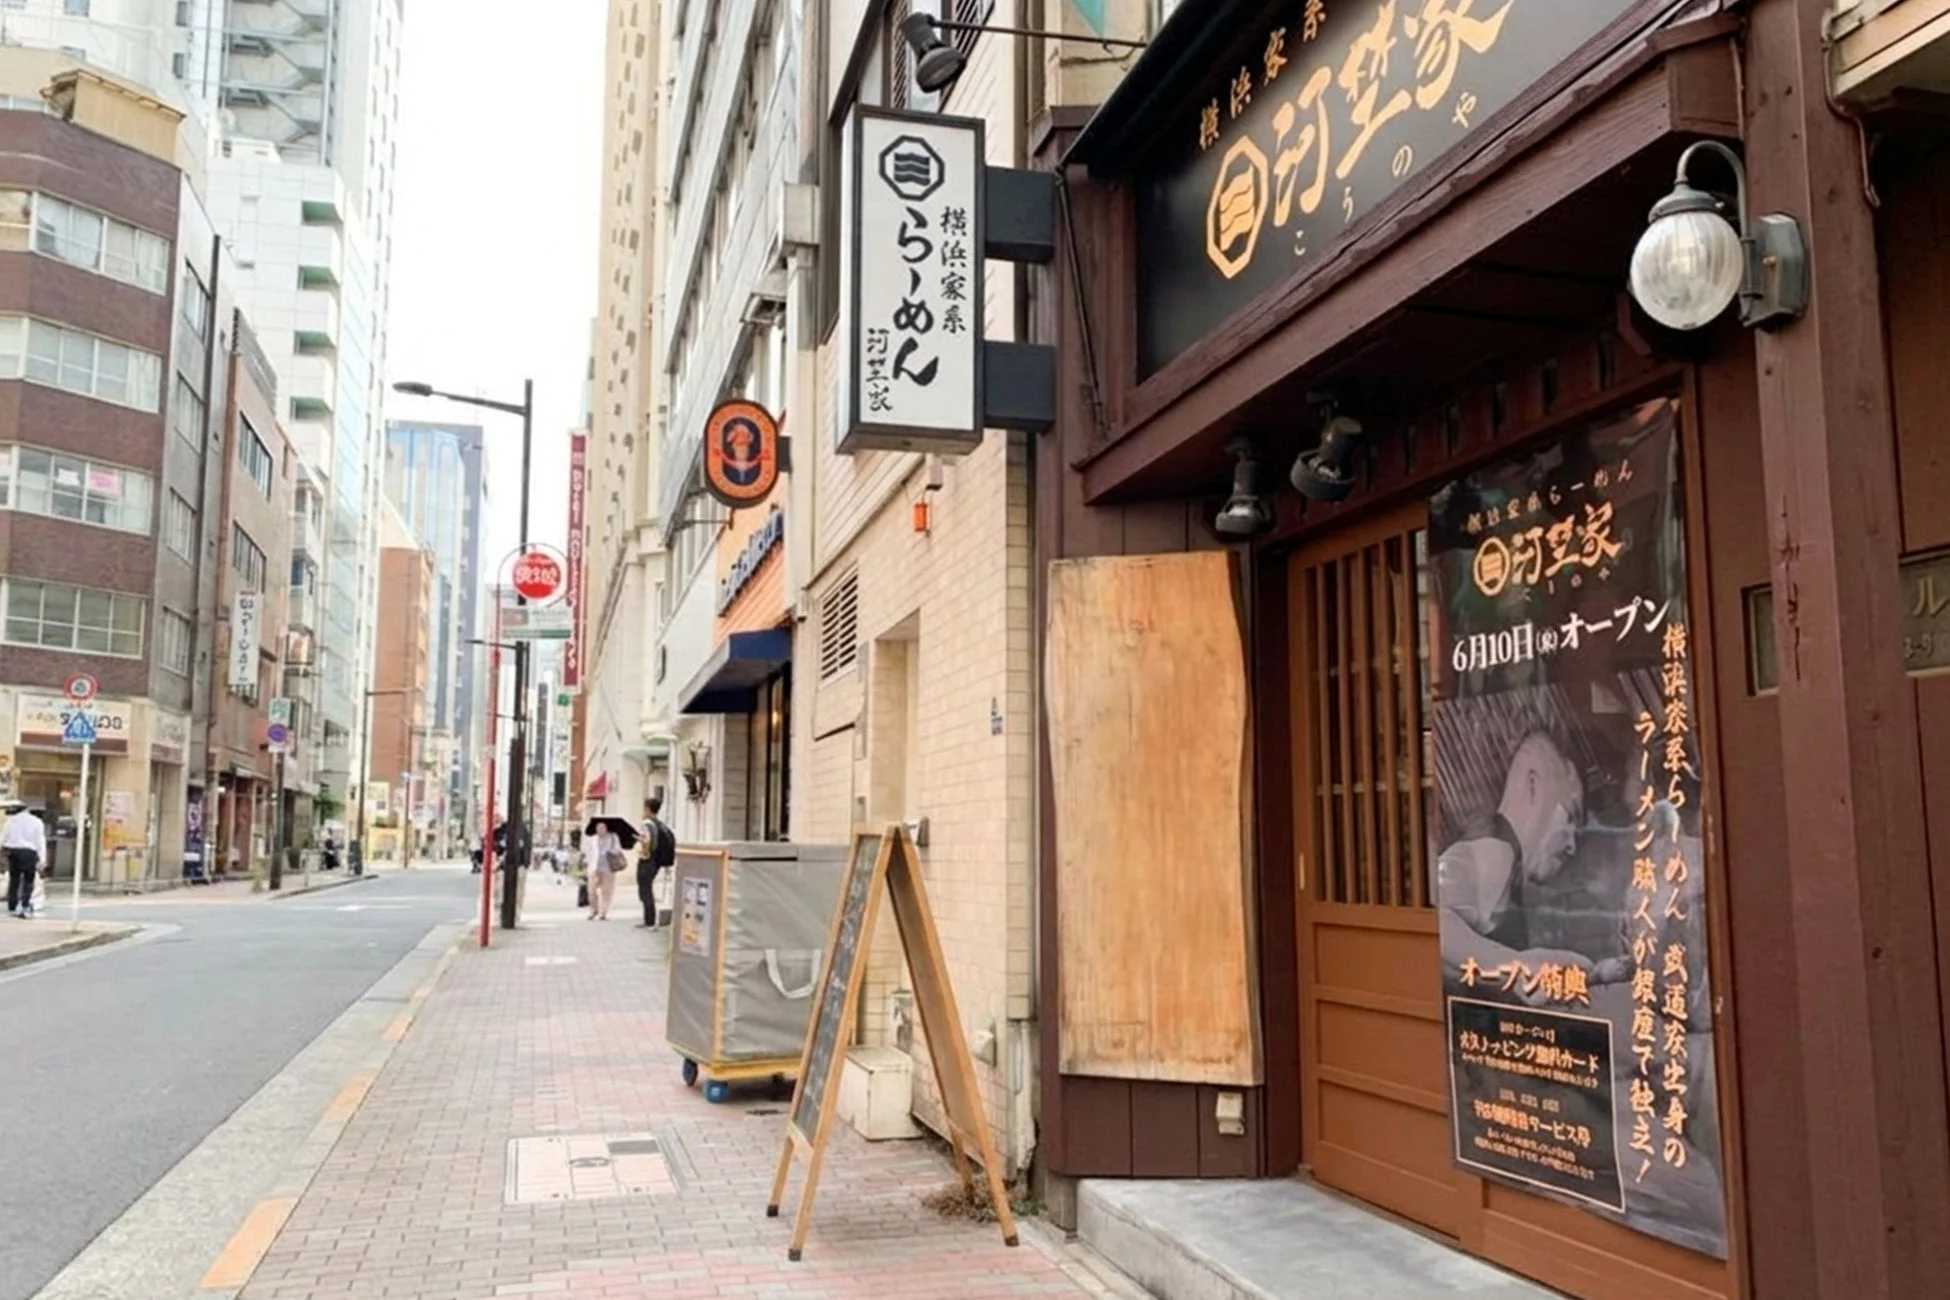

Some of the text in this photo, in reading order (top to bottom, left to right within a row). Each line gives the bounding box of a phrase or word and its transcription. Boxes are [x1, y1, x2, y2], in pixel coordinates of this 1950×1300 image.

[1199, 0, 1327, 151] 横浜家系
[1294, 91, 1478, 255] こうのや
[892, 206, 940, 388] らーめん
[940, 206, 968, 335] 横浜家系
[1459, 956, 1591, 1005] オープン特典
